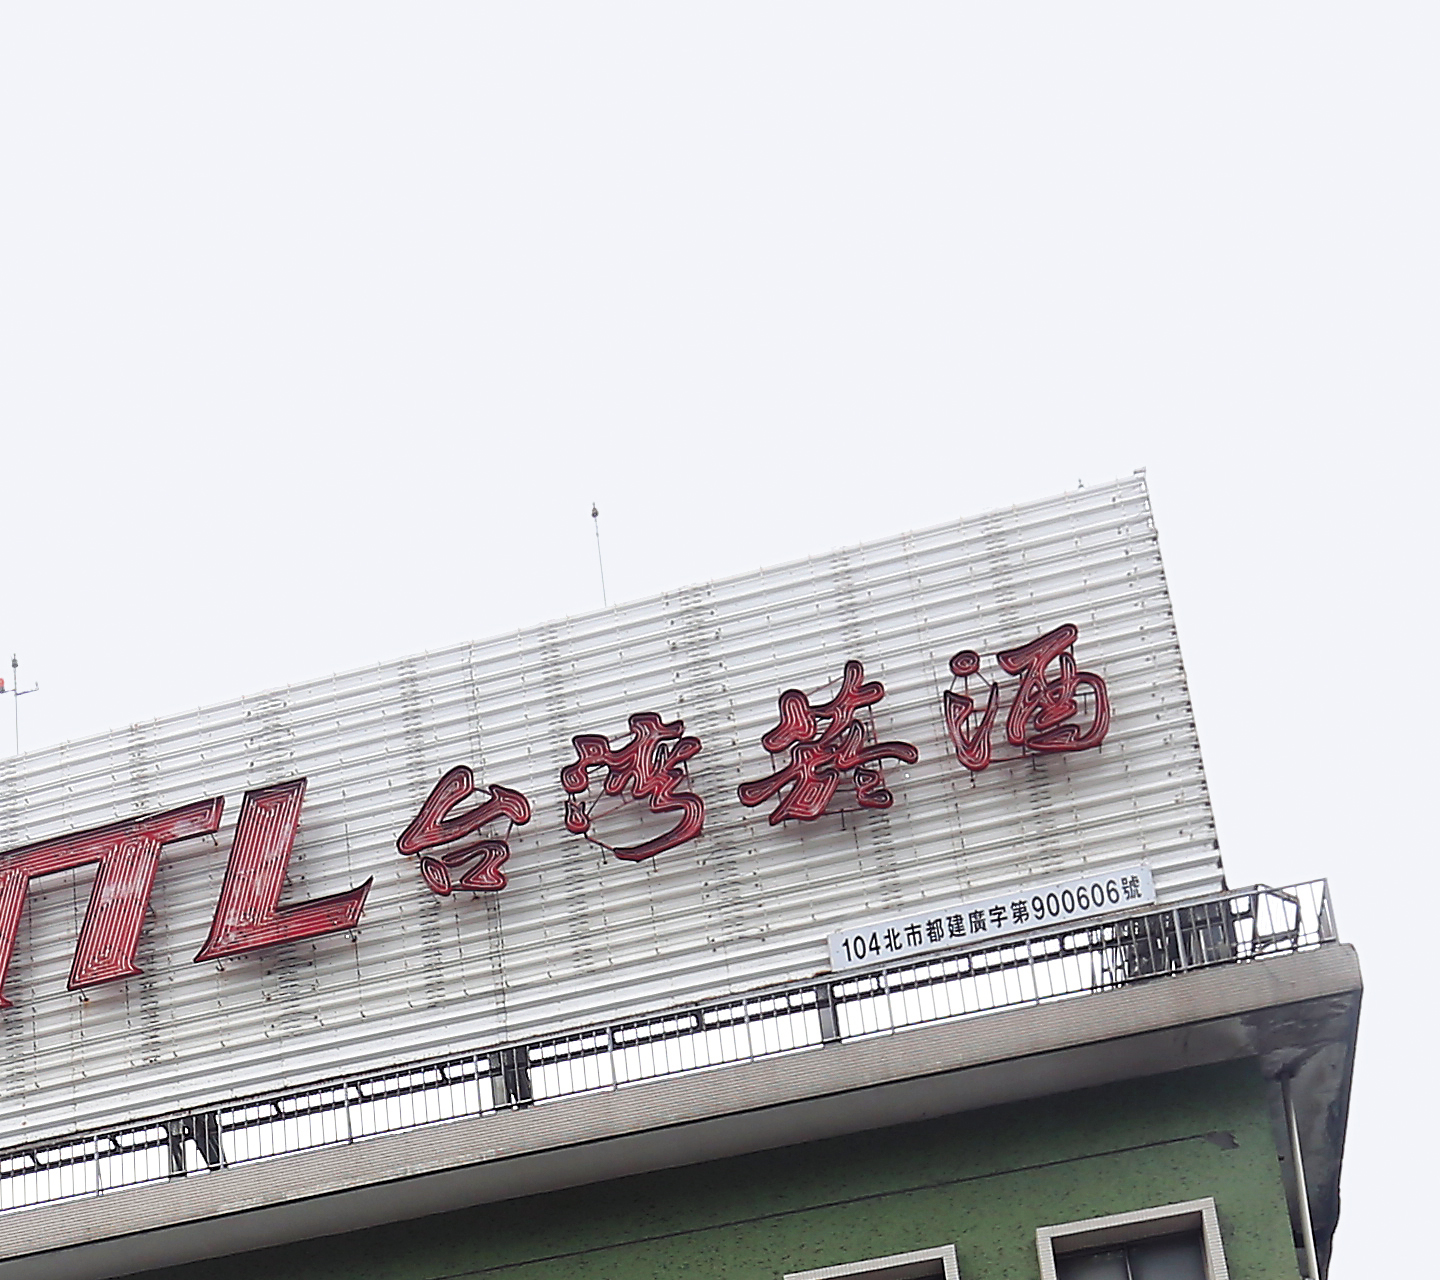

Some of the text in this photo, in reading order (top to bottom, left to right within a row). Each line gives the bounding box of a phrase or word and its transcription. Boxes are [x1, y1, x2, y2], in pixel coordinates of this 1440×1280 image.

[842, 875, 1142, 961] 104北市都建廣字第900606號
